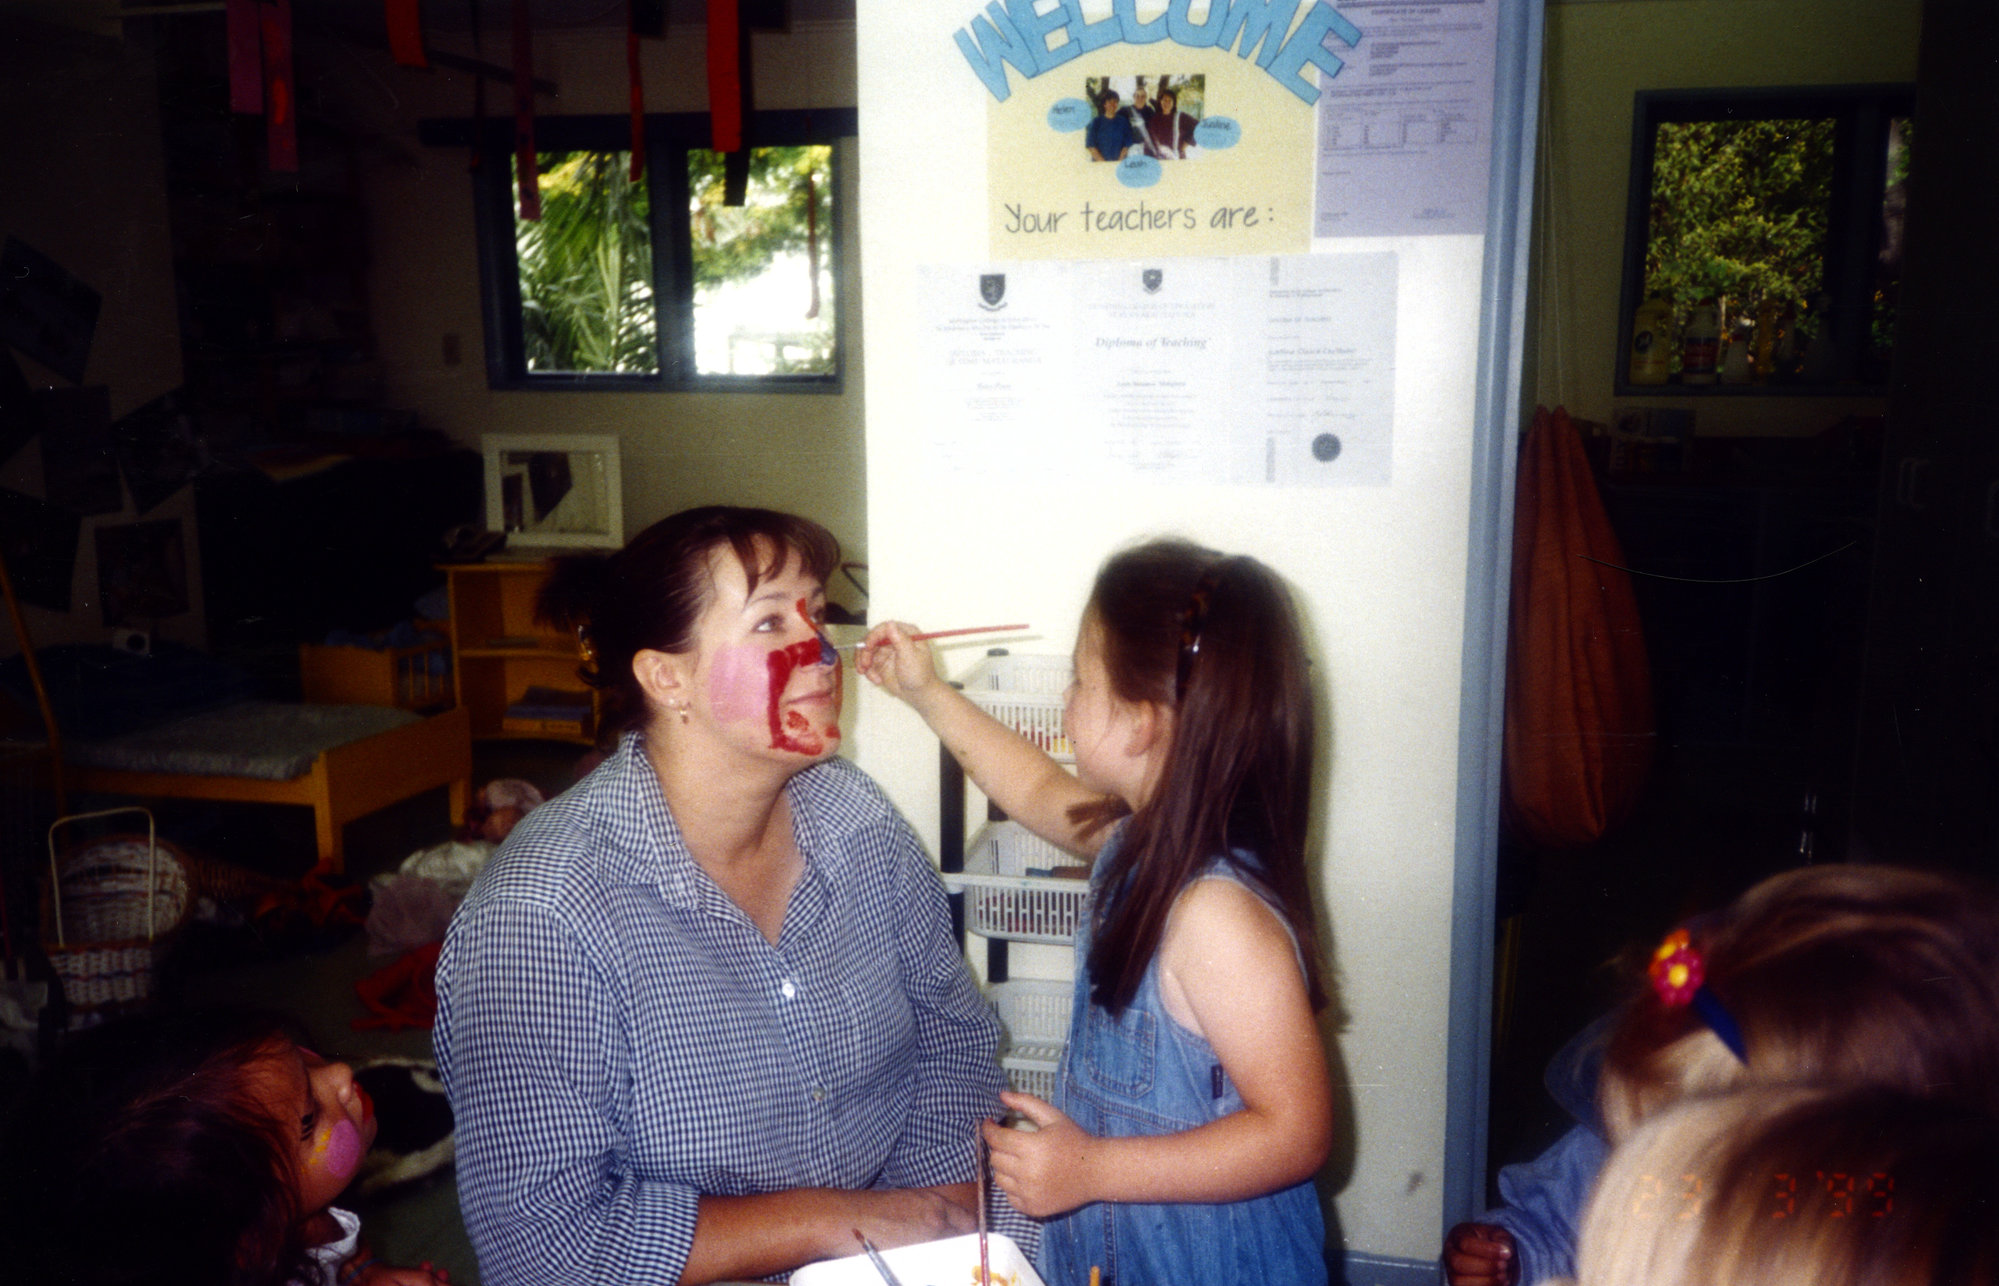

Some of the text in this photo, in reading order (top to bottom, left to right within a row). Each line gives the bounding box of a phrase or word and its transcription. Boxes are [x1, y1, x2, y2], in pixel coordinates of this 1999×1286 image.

[952, 0, 1363, 107] WELCOME
[1004, 203, 1068, 233] Your
[1080, 201, 1197, 232] teachers
[1095, 336, 1207, 351] Diploma of Teaching
